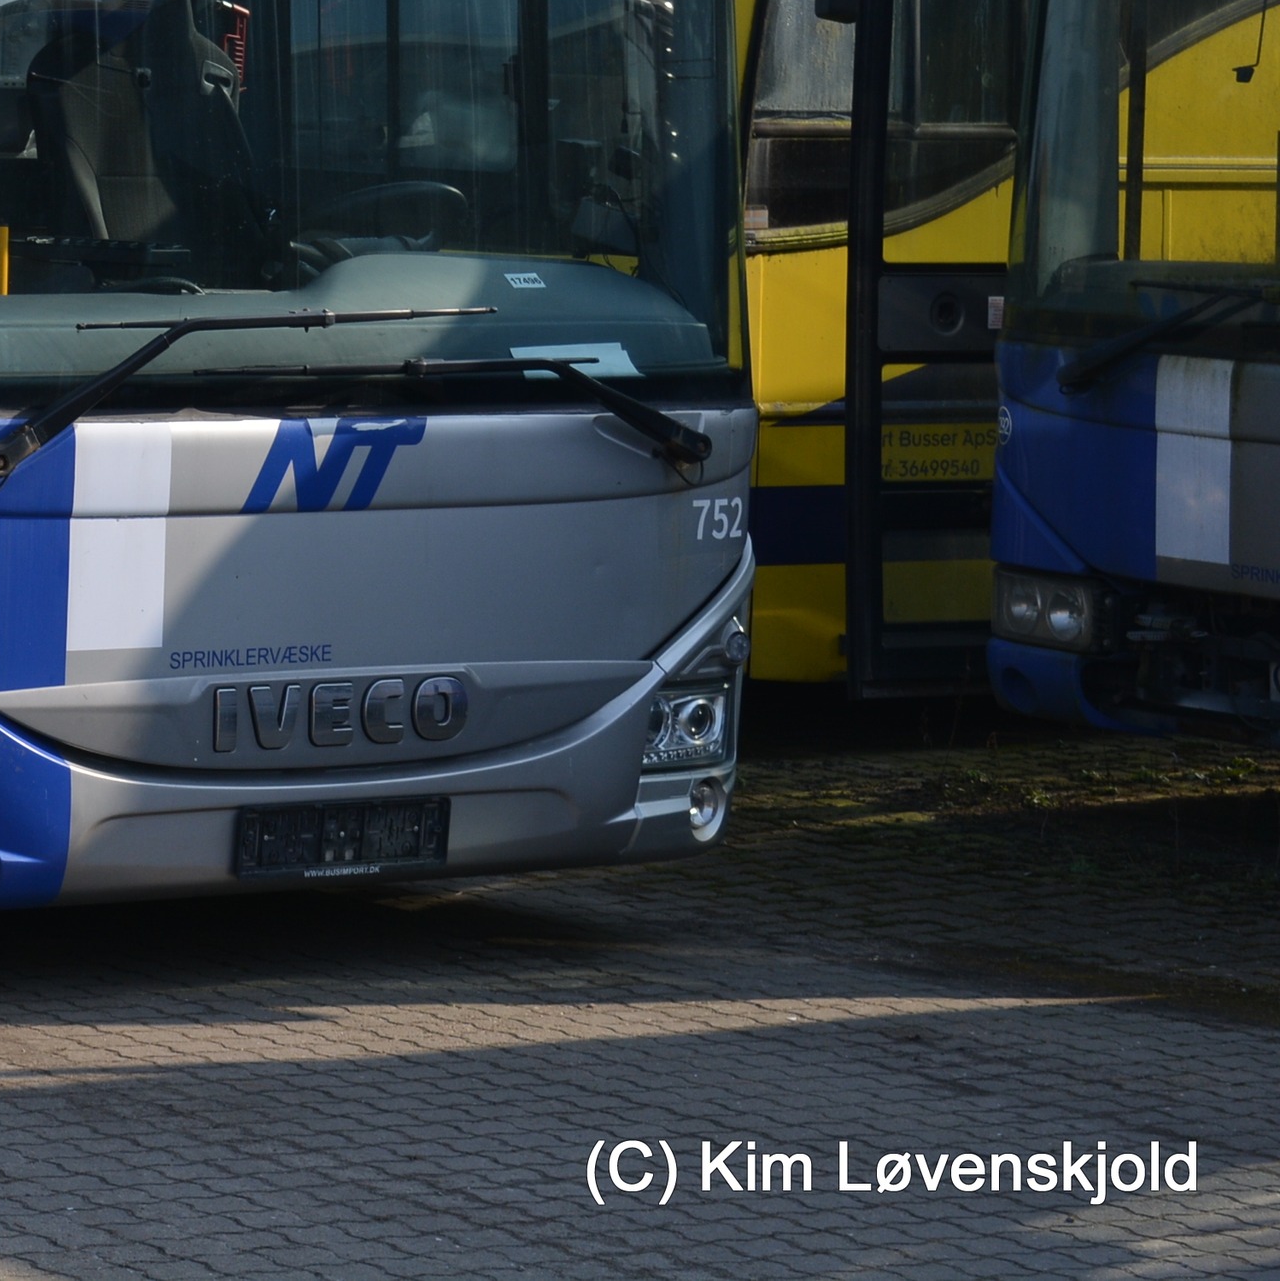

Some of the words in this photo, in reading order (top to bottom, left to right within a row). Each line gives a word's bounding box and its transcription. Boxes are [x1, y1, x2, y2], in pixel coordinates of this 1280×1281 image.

[899, 430, 958, 447] Busser
[962, 429, 997, 450] ApS
[239, 415, 427, 514] NT
[899, 459, 980, 477] 36499540
[692, 496, 743, 541] 752
[169, 644, 332, 670] SPRINKLERVÆSKE
[212, 676, 469, 753] IVECO
